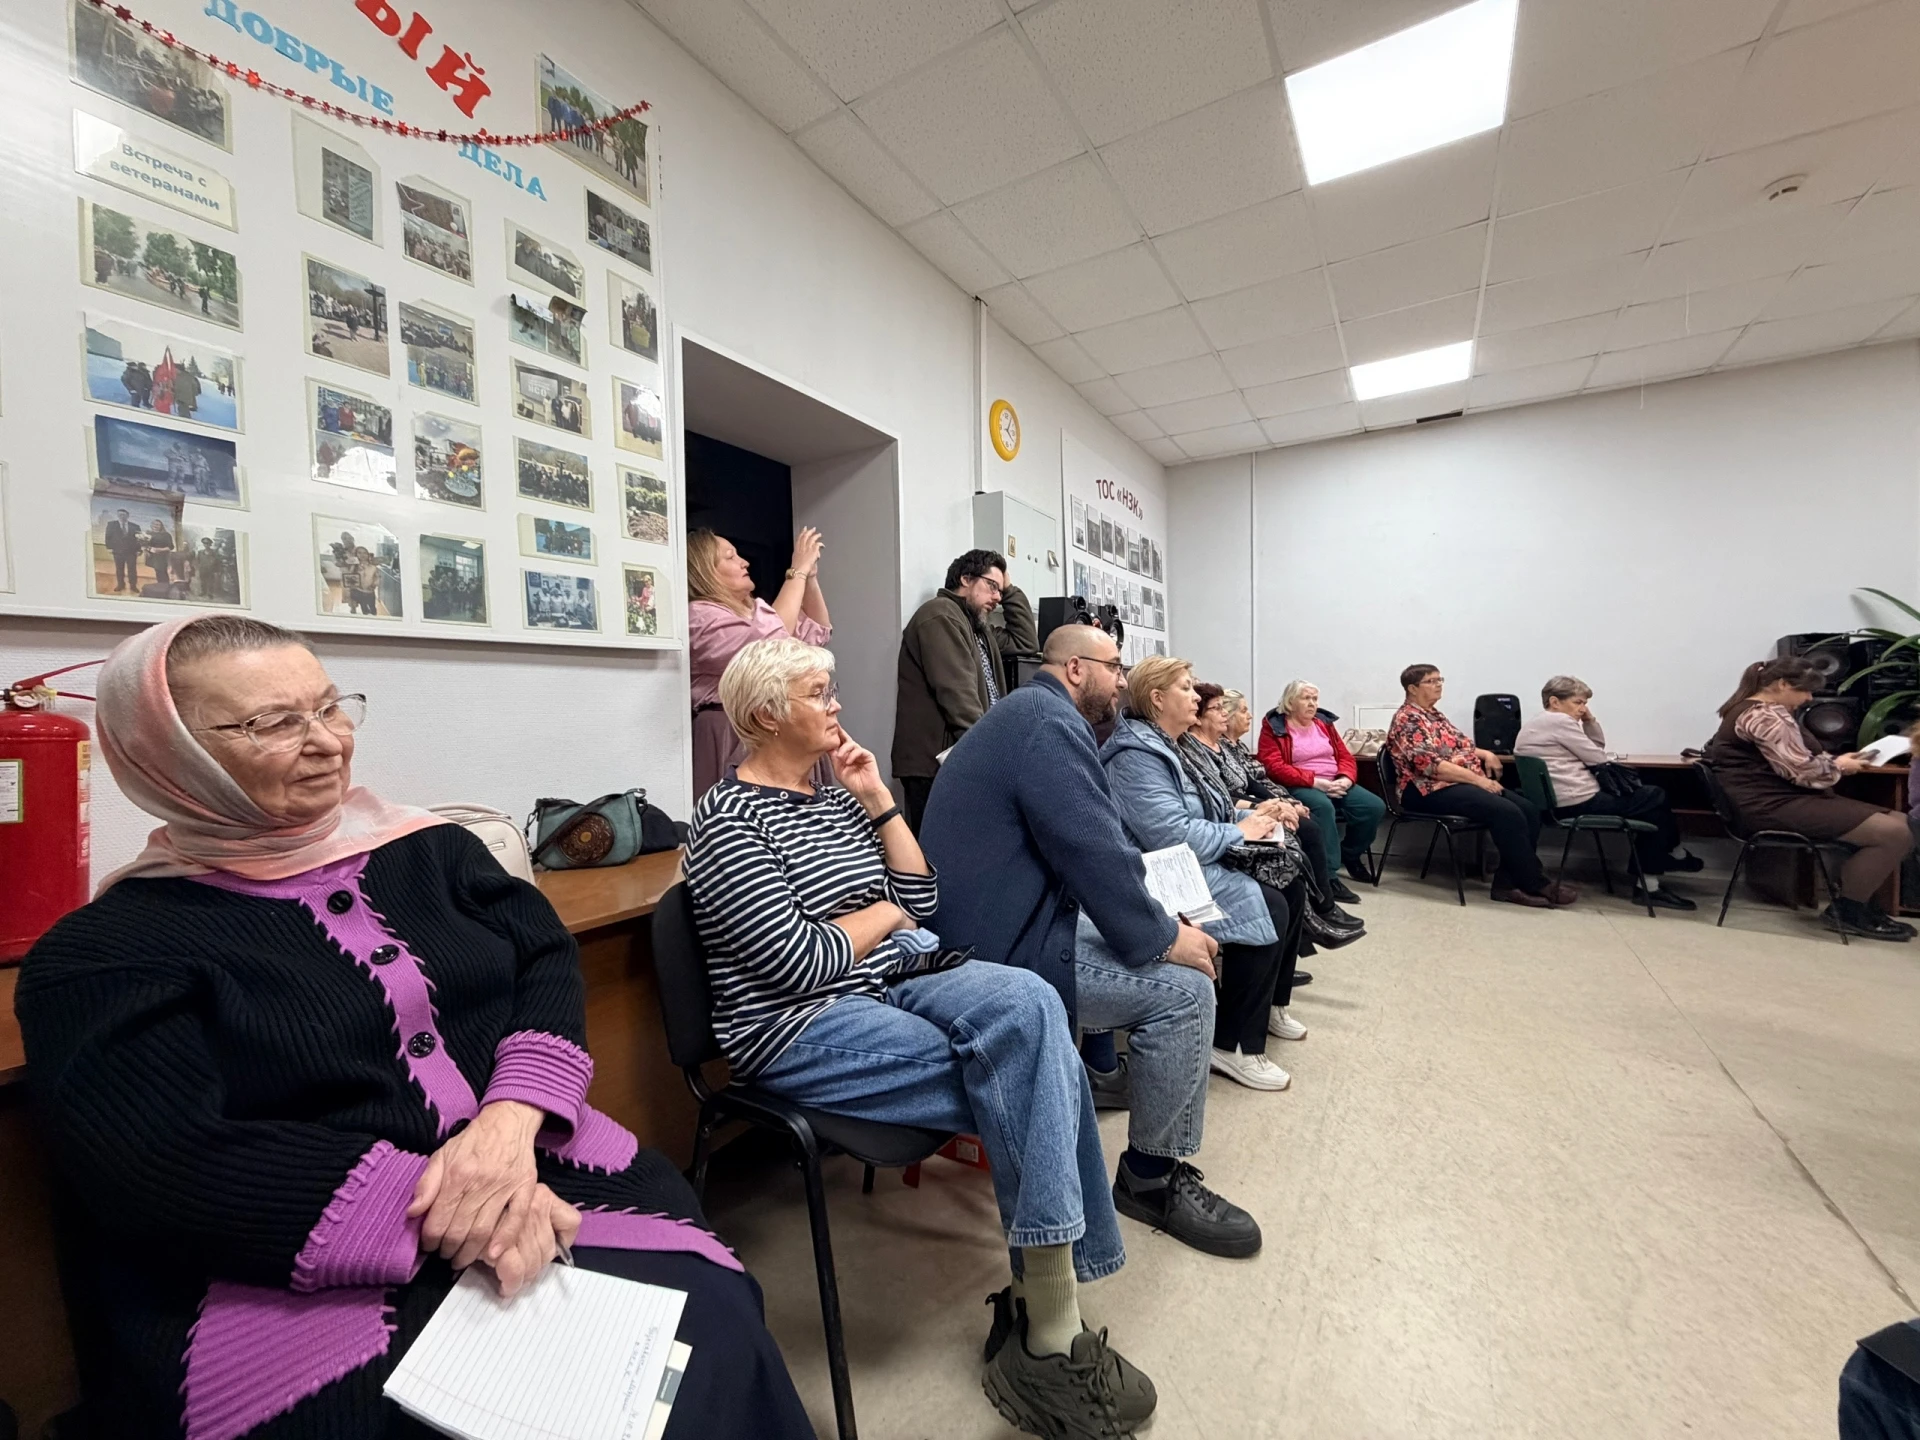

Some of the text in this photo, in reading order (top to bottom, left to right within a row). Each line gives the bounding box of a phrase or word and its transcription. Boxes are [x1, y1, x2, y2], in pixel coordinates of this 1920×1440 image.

[205, 0, 394, 116] ДОБРЫЕ
[110, 160, 220, 210] ветеранами
[122, 143, 207, 188] Встреча с
[458, 139, 547, 202] ДЕЛА
[1095, 479, 1115, 500] ТОС
